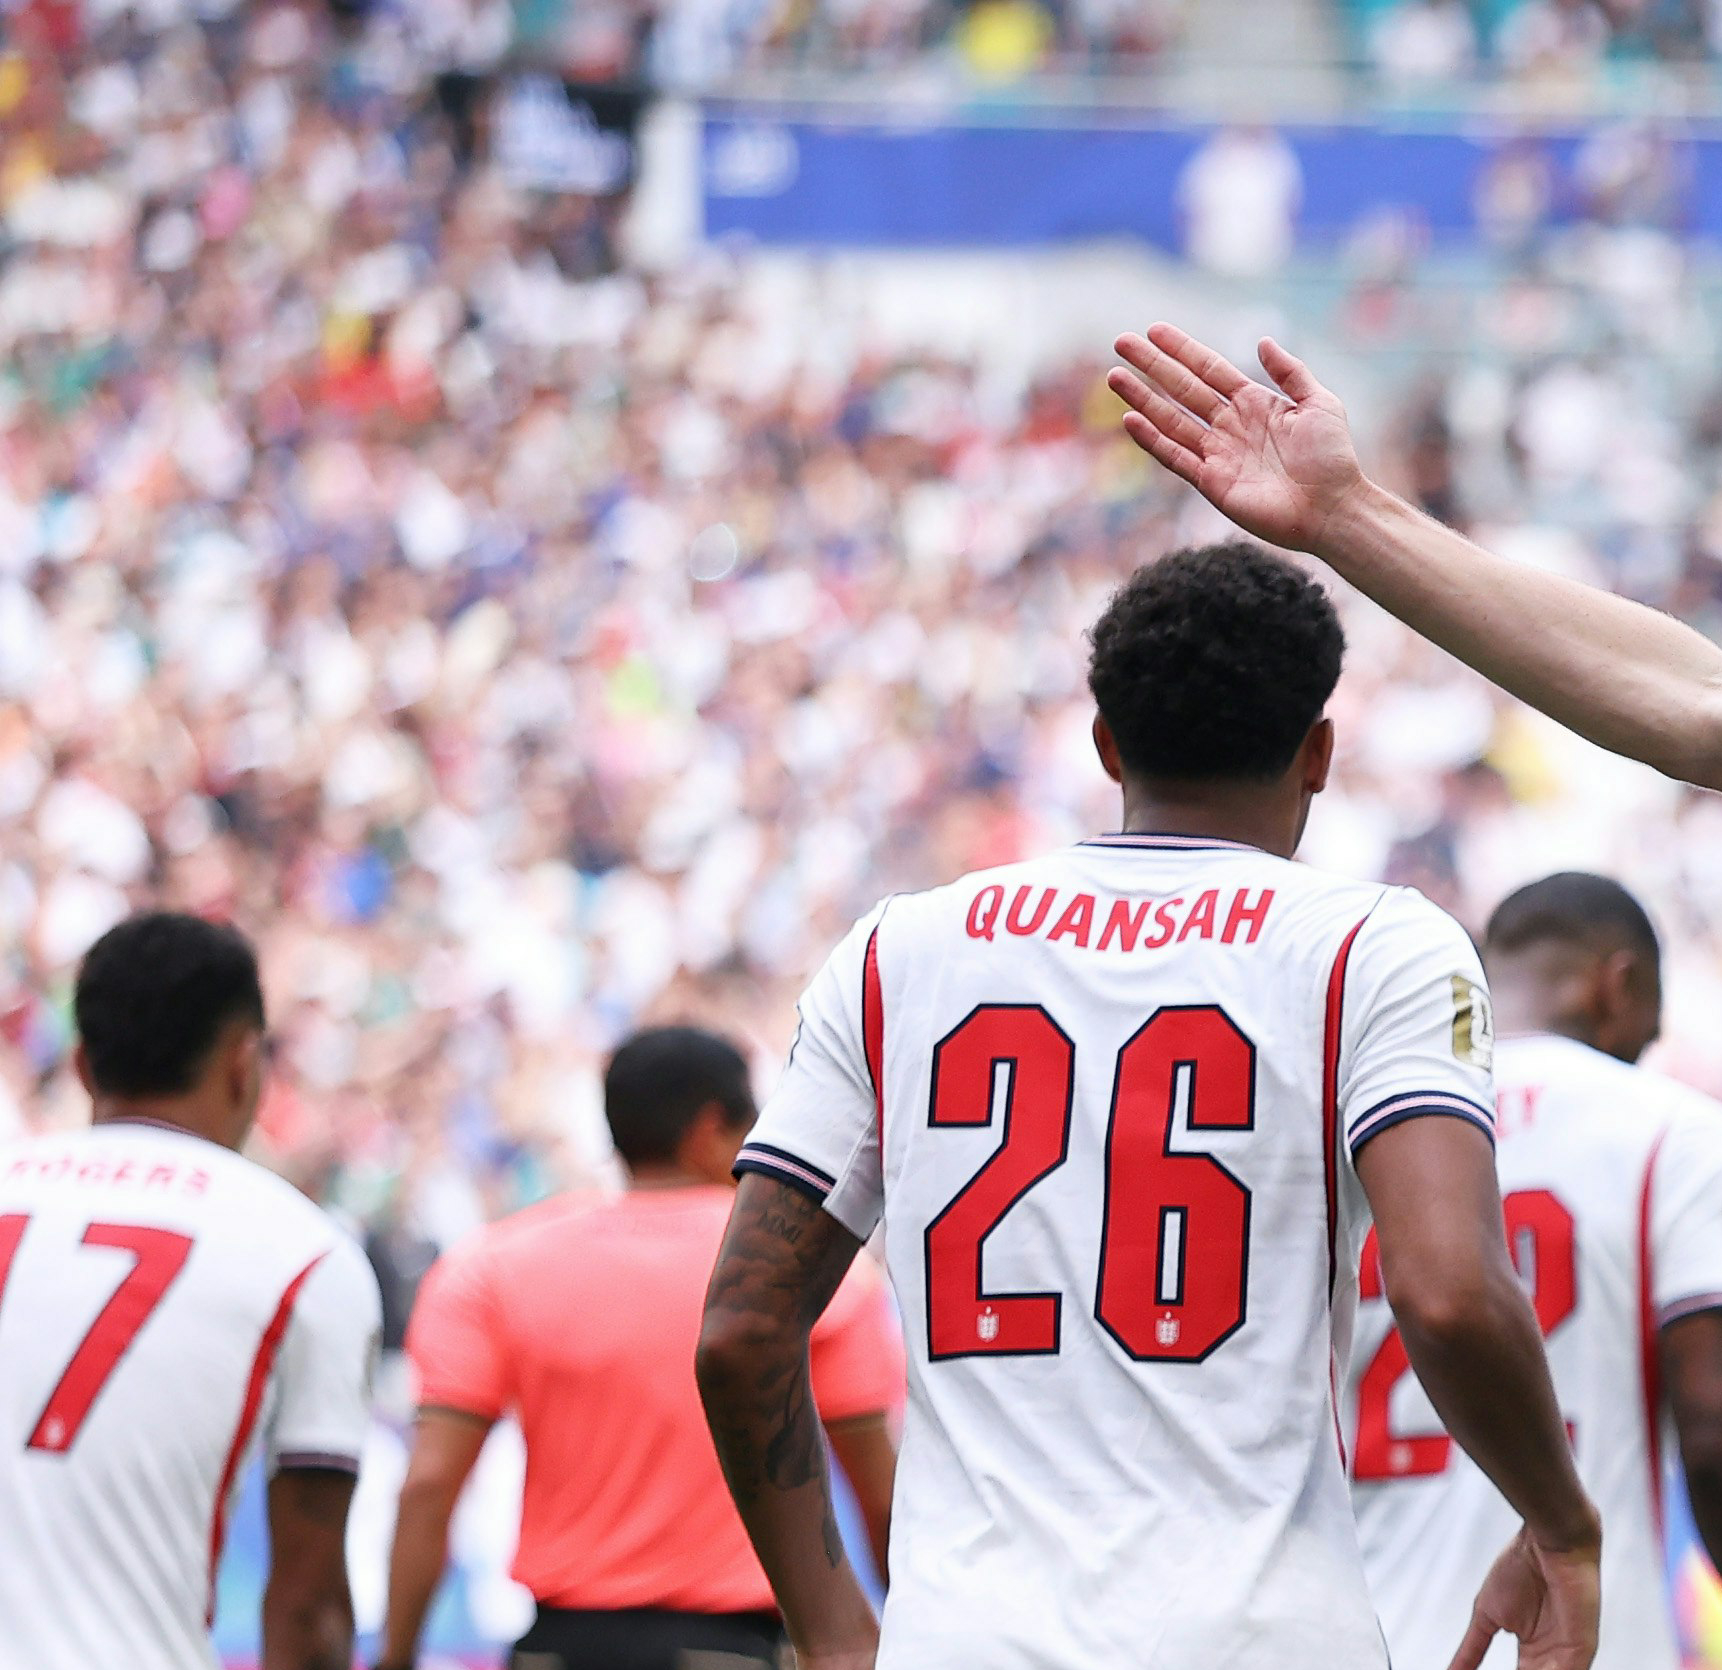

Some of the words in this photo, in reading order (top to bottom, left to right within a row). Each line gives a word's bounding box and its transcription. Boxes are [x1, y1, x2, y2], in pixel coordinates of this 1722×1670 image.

[965, 885, 1275, 952] QUANSAH
[924, 1003, 1257, 1363] 26
[0, 1213, 196, 1455] 7
